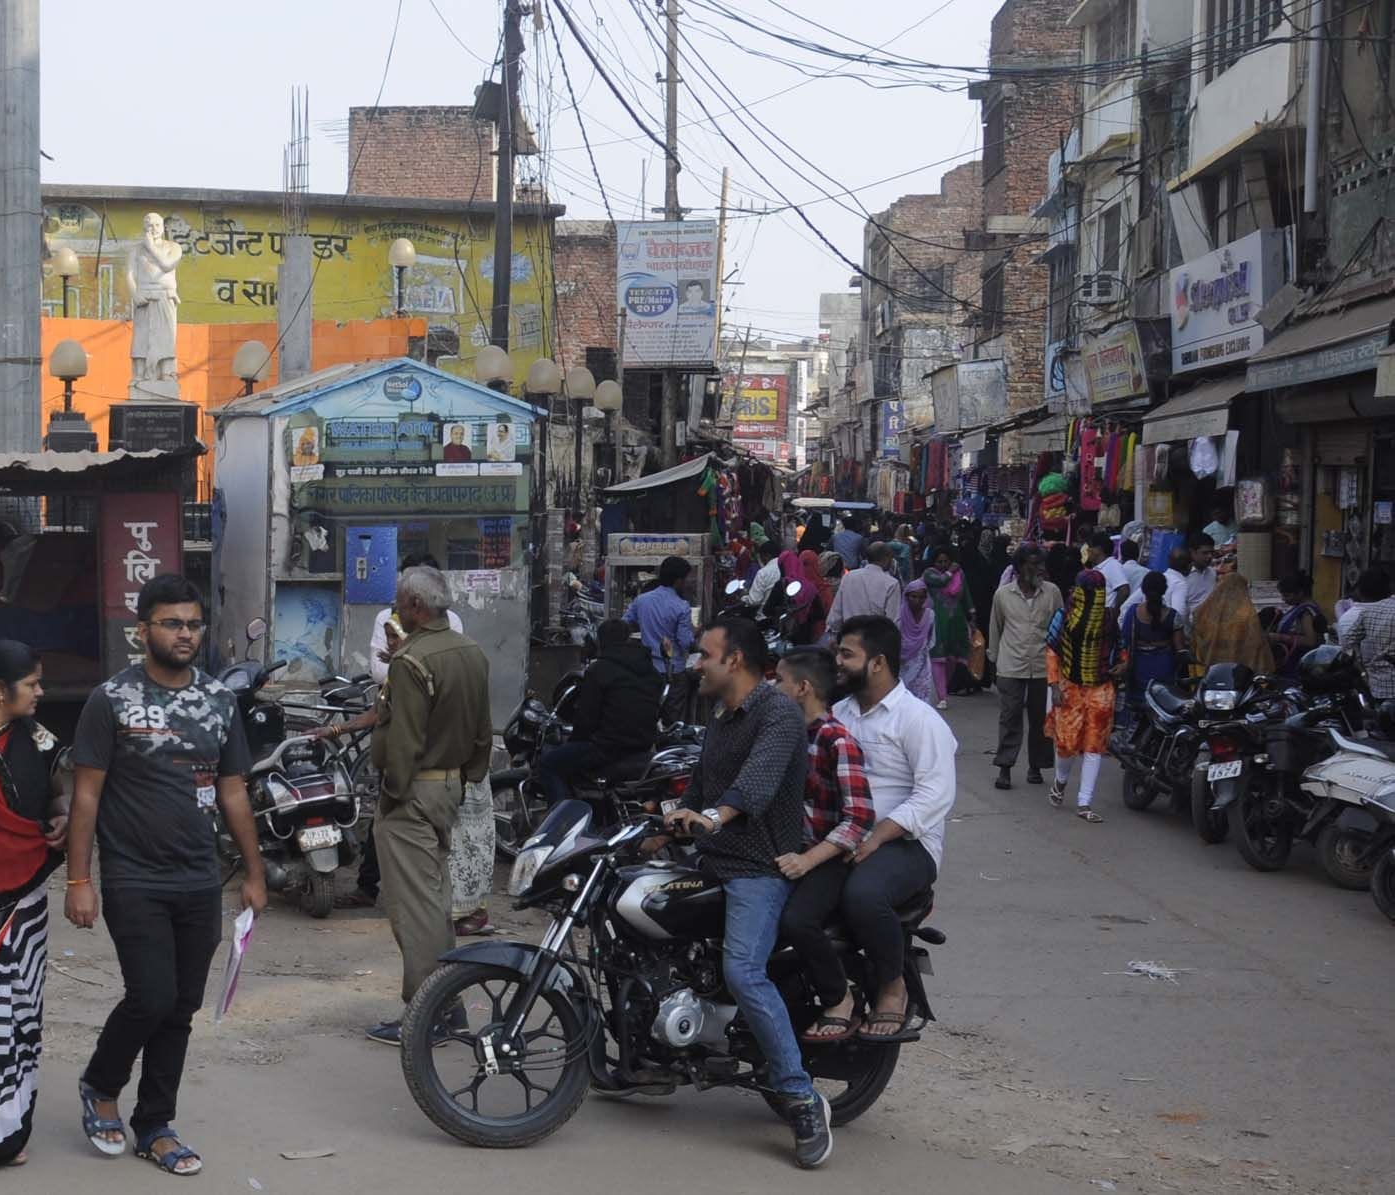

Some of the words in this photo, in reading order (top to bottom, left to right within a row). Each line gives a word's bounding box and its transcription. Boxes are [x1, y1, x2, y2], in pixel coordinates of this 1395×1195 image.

[214, 278, 238, 305] व
[636, 304, 665, 313] 2019
[129, 705, 166, 729] 29
